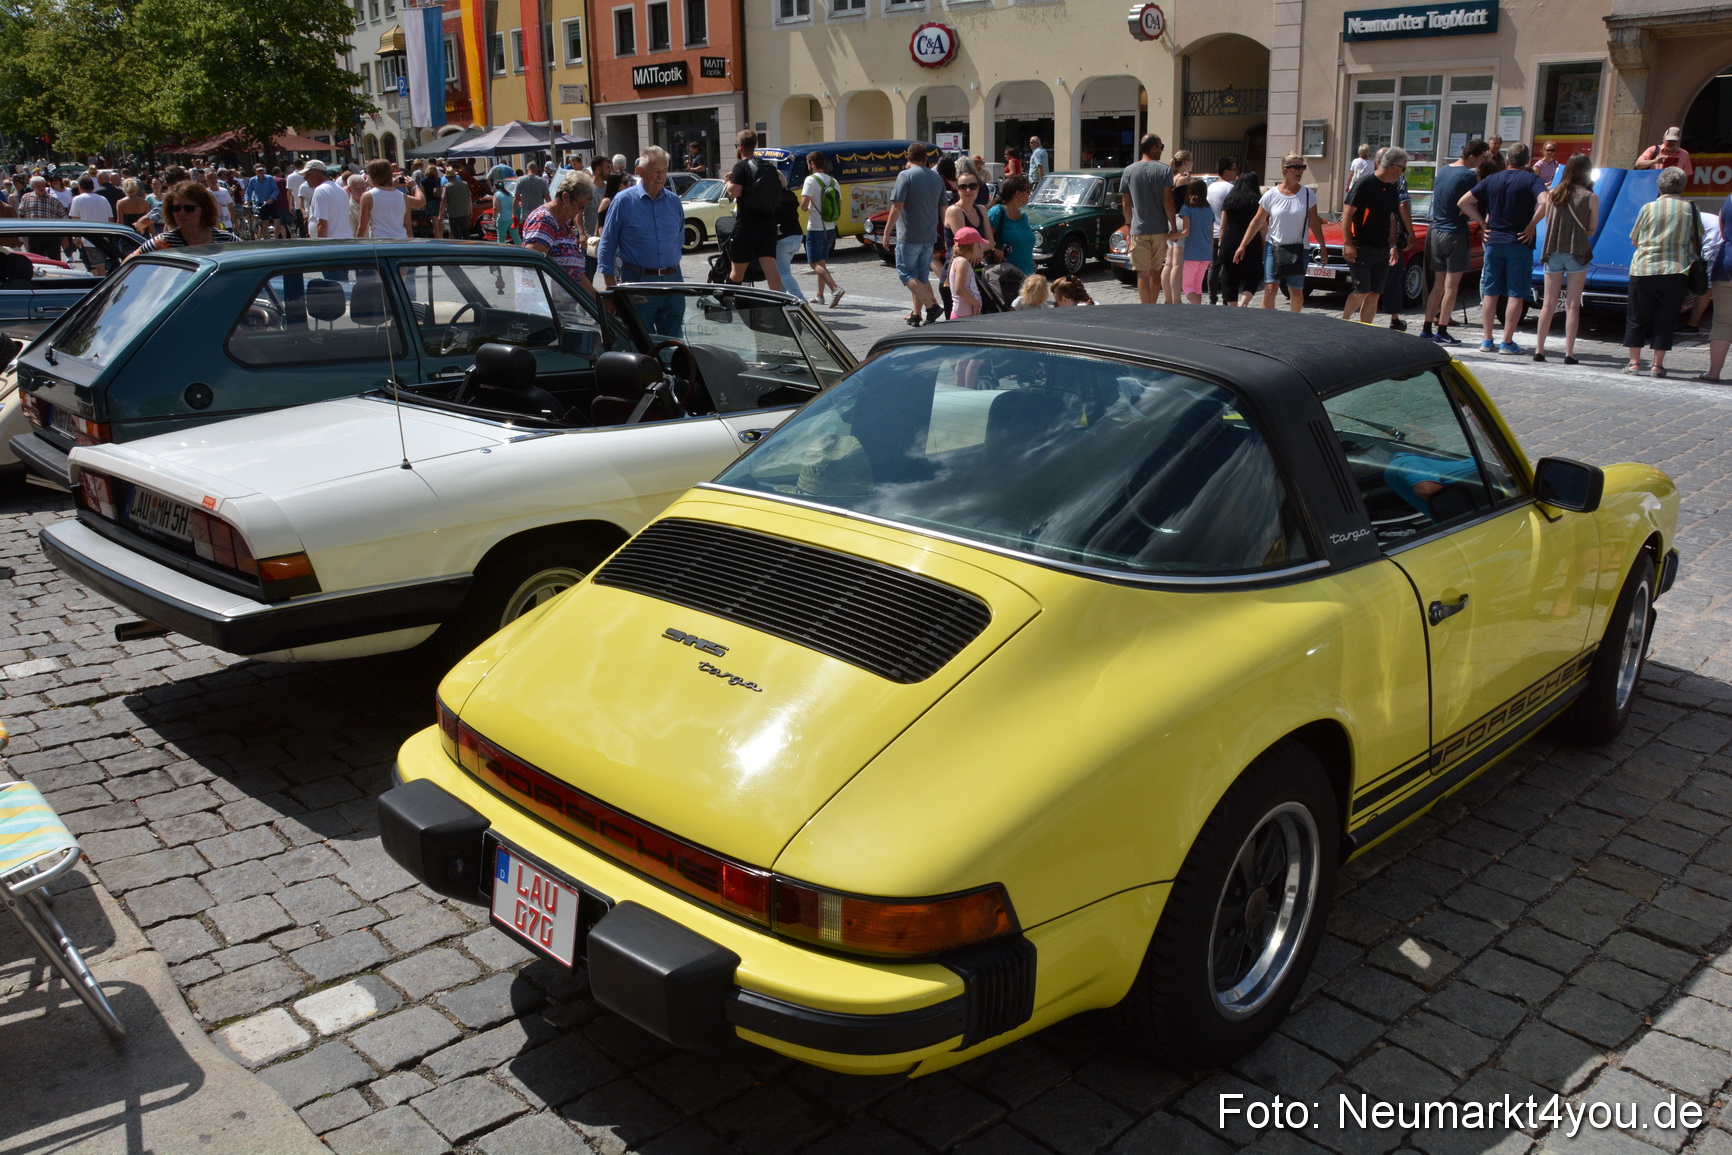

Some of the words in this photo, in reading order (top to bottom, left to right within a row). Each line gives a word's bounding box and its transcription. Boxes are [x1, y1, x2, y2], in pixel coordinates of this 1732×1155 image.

[1145, 13, 1161, 30] C&A
[1347, 13, 1427, 34] Neumarkter
[1427, 9, 1489, 30] Tagblatt
[917, 34, 947, 56] C&A
[703, 59, 725, 68] MATT
[706, 69, 722, 77] optik
[1314, 268, 1332, 277] 0768
[131, 488, 152, 520] LAU
[155, 498, 172, 529] MH
[171, 503, 190, 535] 5H
[1329, 528, 1370, 545] targa
[698, 661, 763, 692] targa
[1441, 661, 1578, 764] PORSCHE
[484, 757, 721, 893] PORSCHE
[516, 862, 559, 917] LAU
